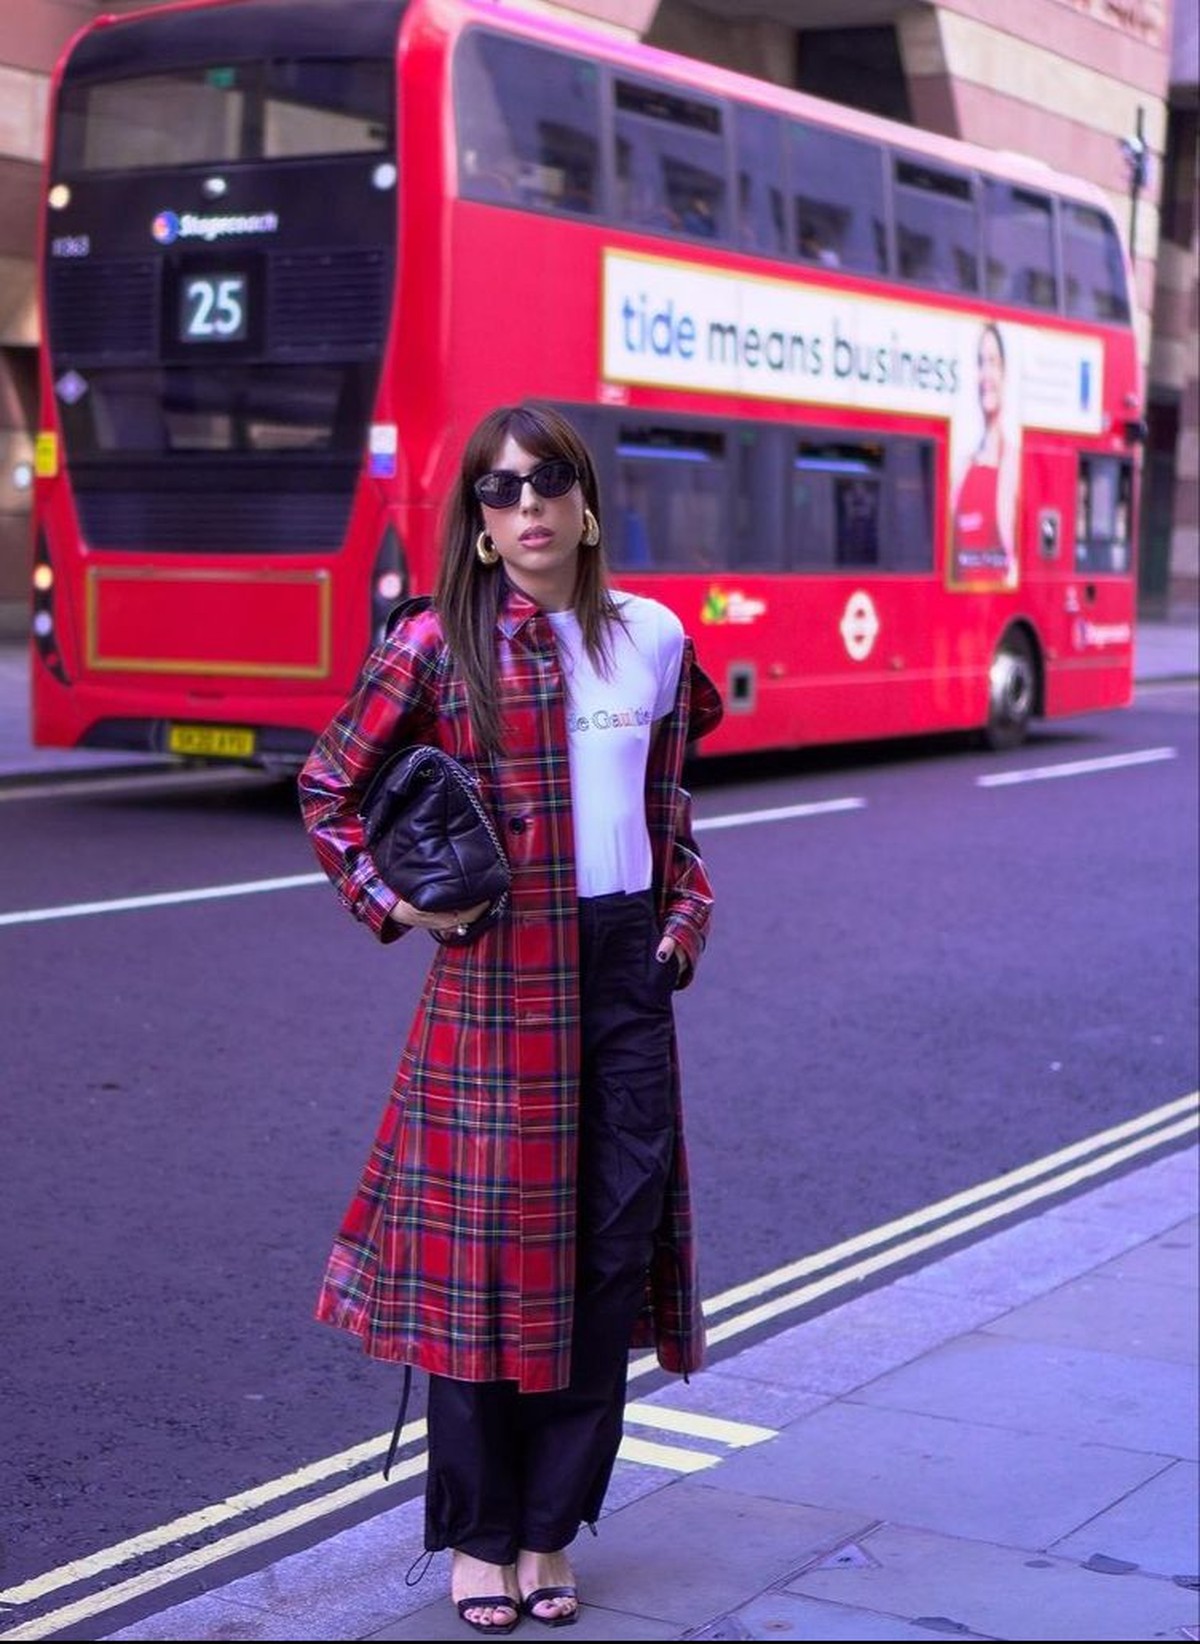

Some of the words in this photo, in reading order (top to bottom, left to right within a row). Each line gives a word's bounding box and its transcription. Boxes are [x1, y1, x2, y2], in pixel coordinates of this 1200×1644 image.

[187, 280, 243, 334] 25
[623, 293, 697, 360] tide
[708, 322, 823, 376] means
[832, 316, 962, 394] business
